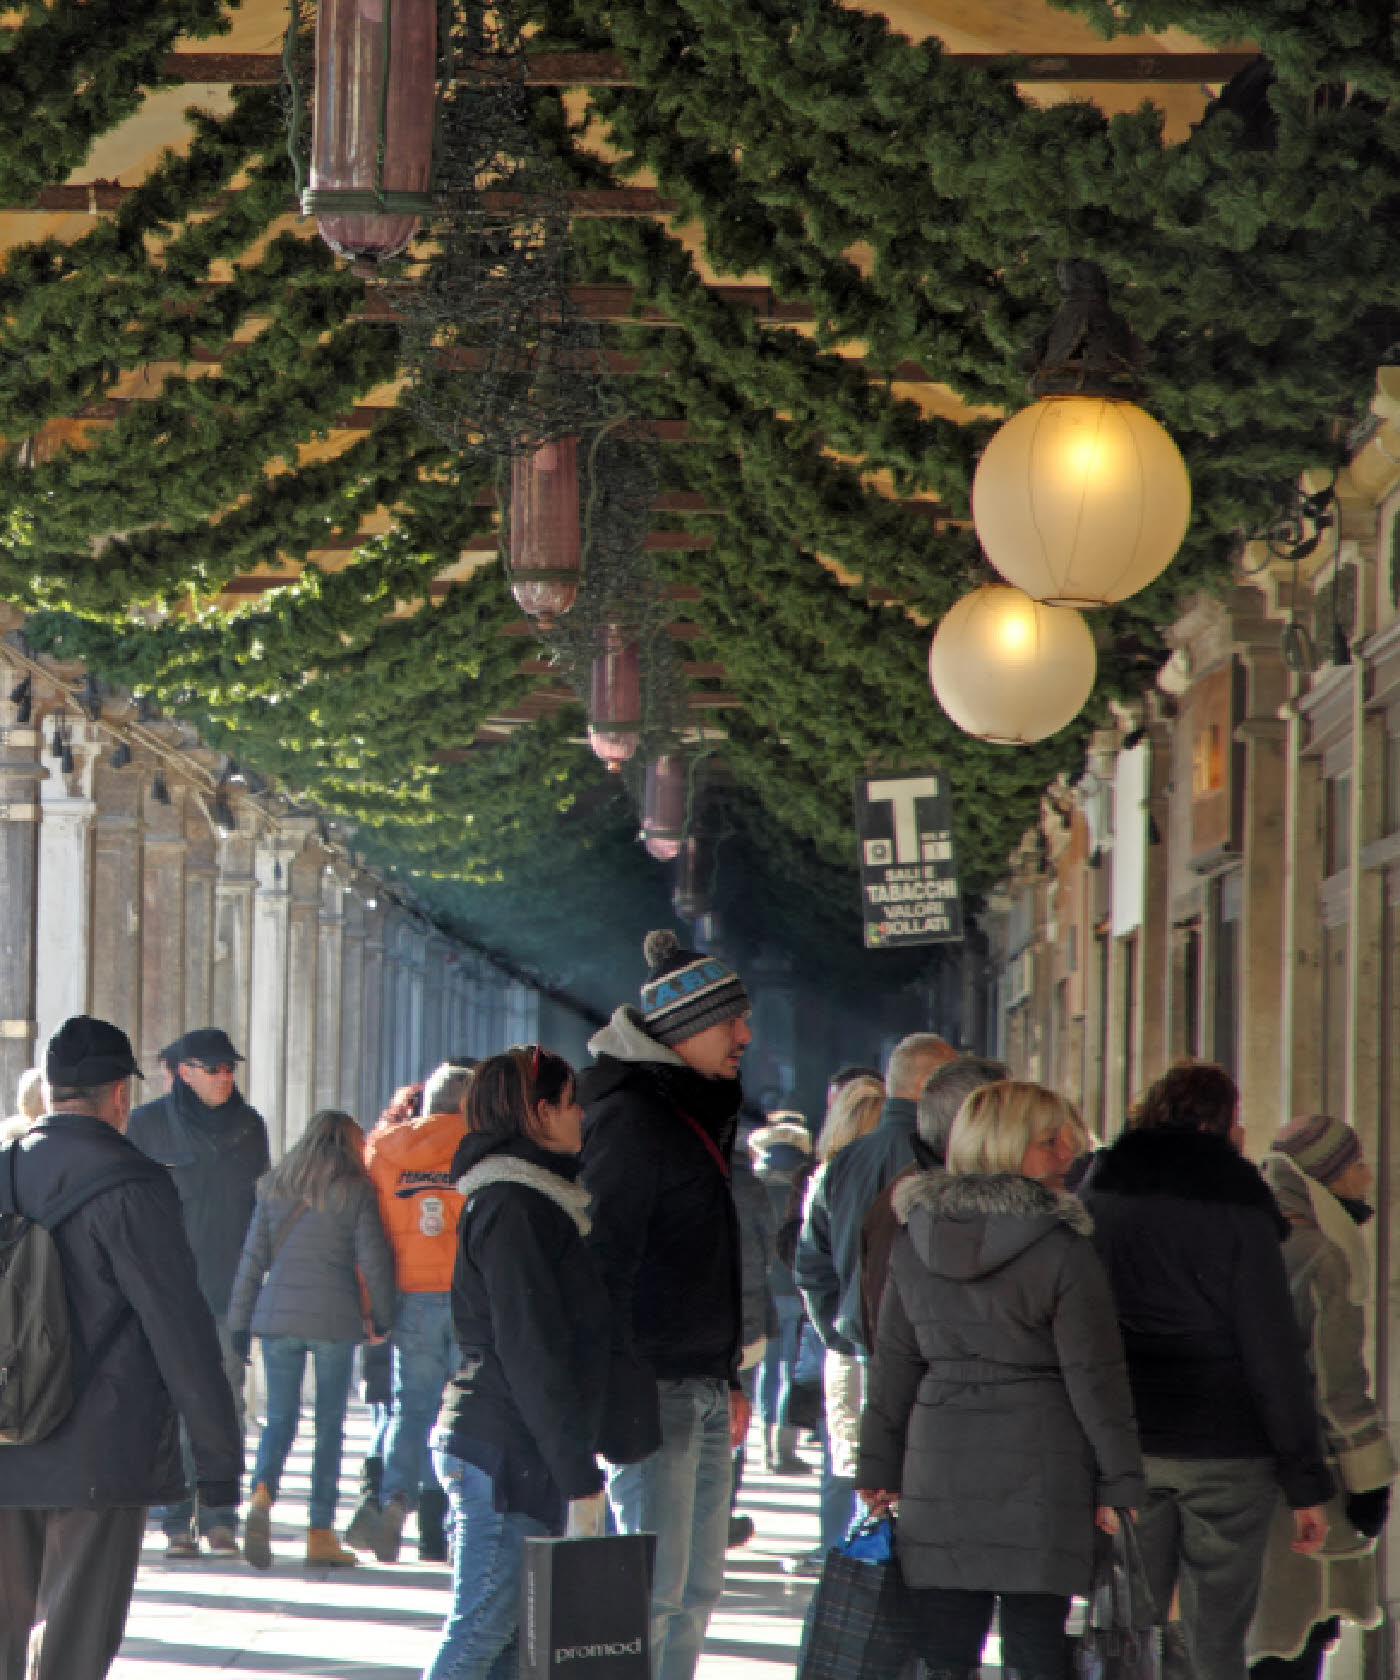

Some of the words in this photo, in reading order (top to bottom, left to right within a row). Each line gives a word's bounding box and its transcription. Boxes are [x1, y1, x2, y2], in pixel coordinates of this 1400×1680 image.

[867, 776, 939, 864] T
[884, 867, 921, 882] SALI
[864, 878, 958, 905] TABACCHI
[881, 901, 945, 919] VALORI
[555, 1636, 642, 1664] promod
